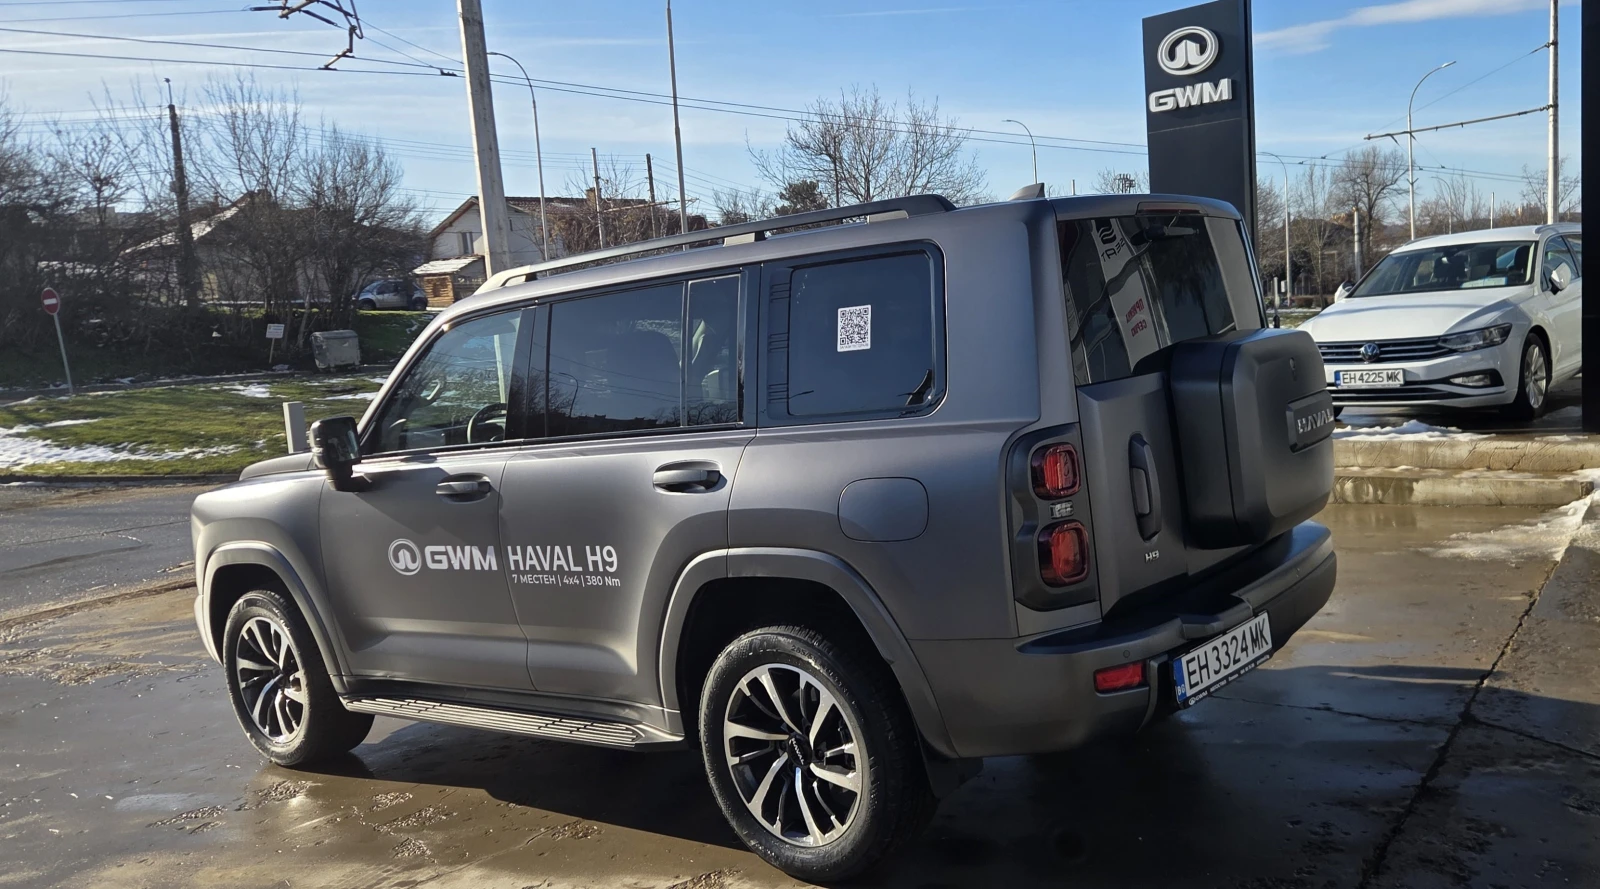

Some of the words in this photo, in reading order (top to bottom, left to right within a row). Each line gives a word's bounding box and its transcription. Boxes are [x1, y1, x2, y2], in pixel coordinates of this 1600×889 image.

[1149, 78, 1232, 112] GWM
[1342, 373, 1356, 384] EH
[1358, 372, 1384, 383] 4225
[1386, 371, 1401, 382] MK
[1297, 408, 1334, 434] HAVAL
[424, 545, 498, 571] GWM
[507, 545, 583, 571] HAVAL
[585, 545, 618, 573] H9
[1144, 549, 1160, 563] H9
[511, 574, 518, 583] 7
[520, 574, 556, 584] МЕСТЕН
[563, 575, 580, 585] 4x4
[585, 575, 603, 586] 380
[605, 576, 621, 587] Nm
[1185, 650, 1211, 690] EH
[1211, 629, 1249, 675] 3324
[1249, 618, 1269, 654] MK
